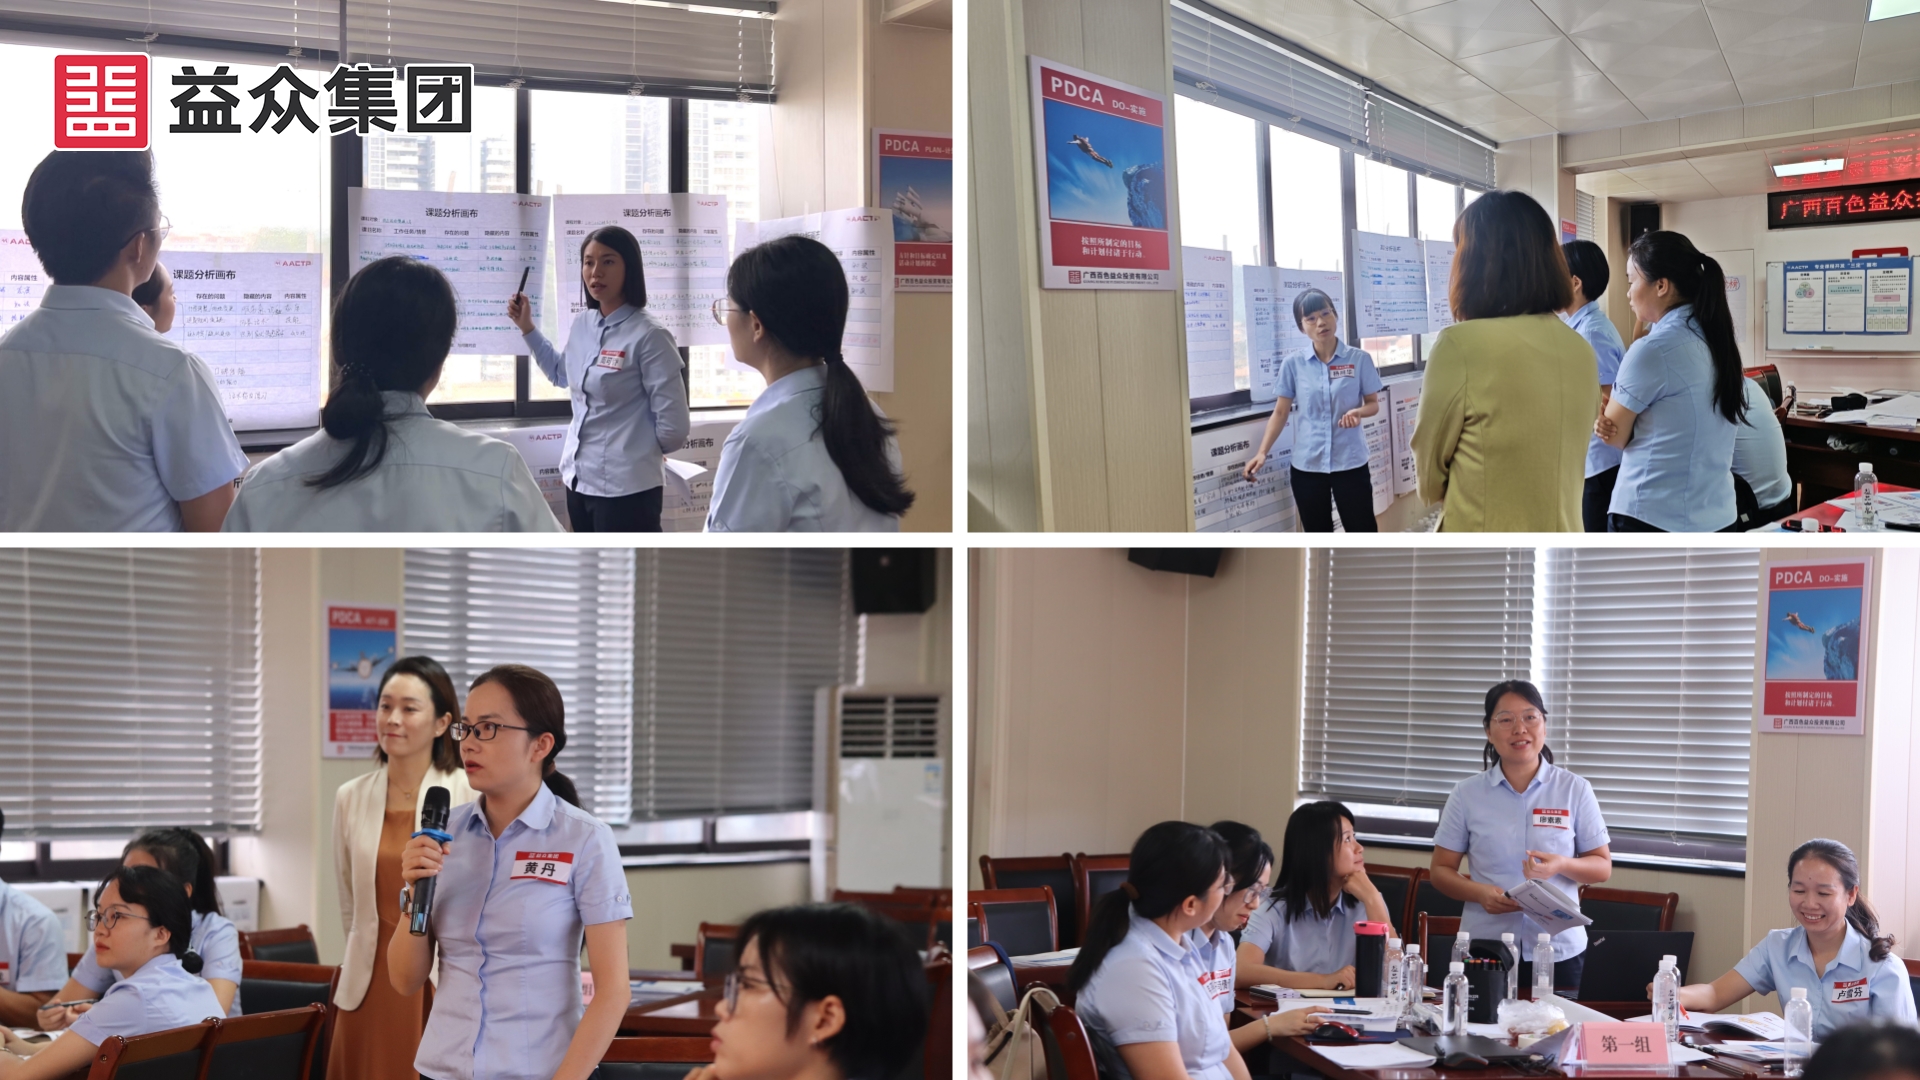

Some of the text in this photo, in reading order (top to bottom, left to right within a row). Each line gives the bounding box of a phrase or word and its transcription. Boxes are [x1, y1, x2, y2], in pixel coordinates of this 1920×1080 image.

[1050, 76, 1148, 117] PDCA DO-实施
[884, 138, 952, 155] PDCA PLAN-计
[1780, 189, 1920, 220] 广西百色益众
[425, 207, 479, 219] 课题分析画布
[622, 208, 672, 218] 课题分析画布
[1081, 236, 1143, 250] 按照所制定的目标
[10, 274, 38, 282] 内容属性
[173, 269, 237, 281] 课题分析画布
[1082, 270, 1160, 281] 广西百色益众投资有限公司
[535, 433, 563, 442] AACTP
[1210, 440, 1251, 458] 课题分析画布
[1775, 570, 1848, 585] PDCA DO-实施
[331, 609, 363, 625] PDCA
[1784, 691, 1833, 699] 按照所制定的目标
[1783, 718, 1846, 727] 广西百色益众投资有限公司
[523, 861, 556, 877] 黄丹
[1601, 1035, 1652, 1053] 第一组
